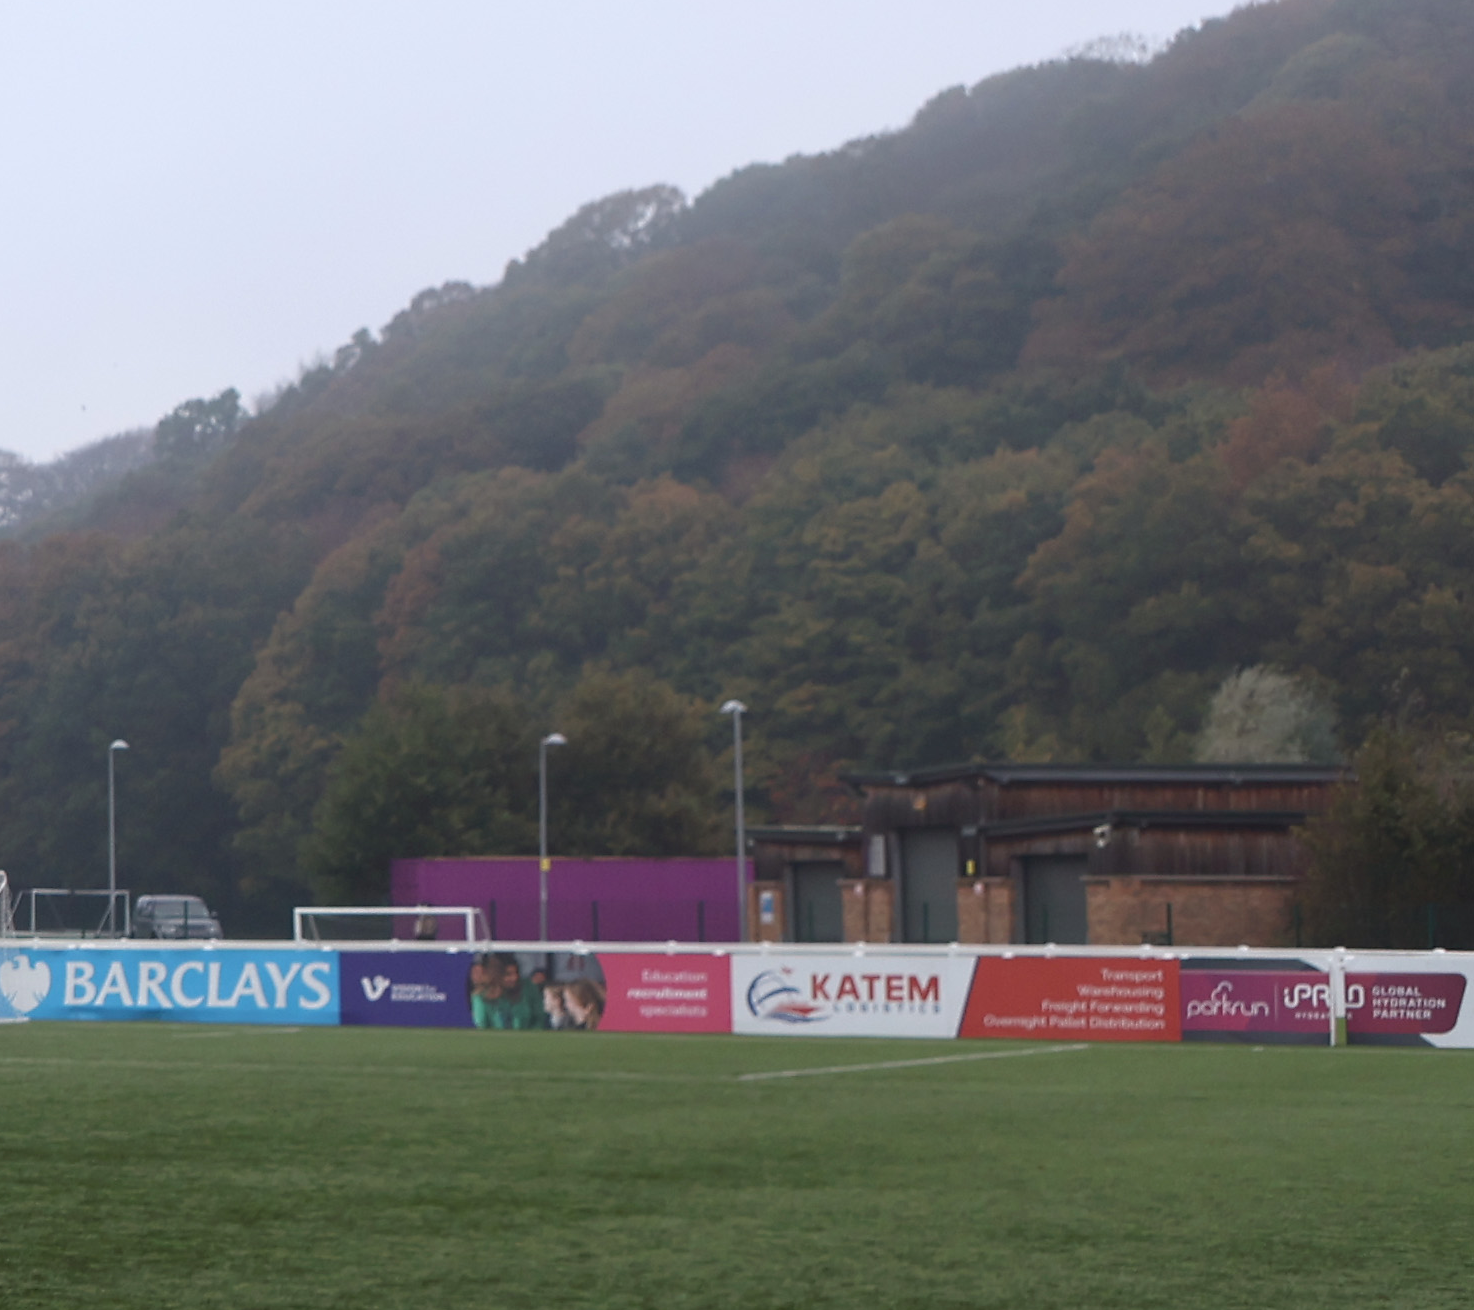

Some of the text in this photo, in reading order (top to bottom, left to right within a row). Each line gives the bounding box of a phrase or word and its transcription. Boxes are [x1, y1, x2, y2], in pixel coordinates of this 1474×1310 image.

[1101, 968, 1164, 983] Transport
[64, 961, 331, 1009] BARCLAYS
[810, 974, 940, 1002] KATEM
[1077, 985, 1165, 1000] Warehousing
[1372, 985, 1421, 997] GLOBAL
[1041, 999, 1165, 1016] Freight Forwarding
[1187, 991, 1269, 1019] parkrun
[1372, 997, 1447, 1008] HYDRATION
[983, 1014, 1165, 1030] Overnight Pallet Distribution
[1372, 1009, 1432, 1020] PARTNER
